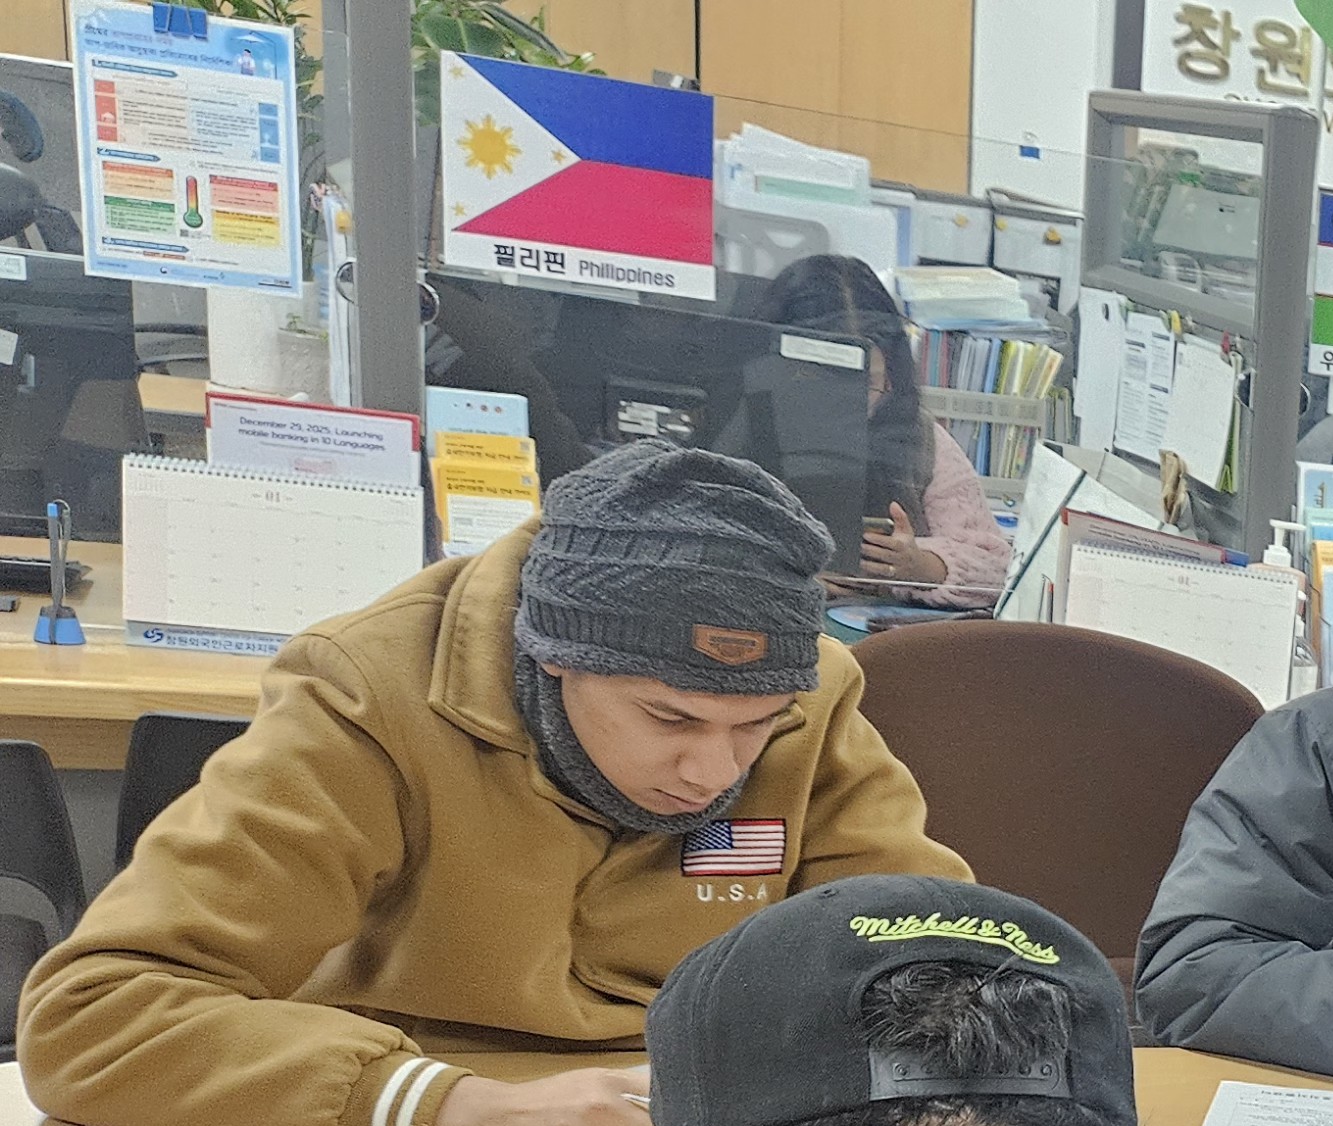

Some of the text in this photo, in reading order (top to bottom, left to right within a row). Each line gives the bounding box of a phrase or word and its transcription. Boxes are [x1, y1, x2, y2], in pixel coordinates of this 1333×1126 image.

[493, 244, 566, 275] 필리핀
[578, 259, 676, 288] Philippines
[238, 427, 269, 439] mobile
[272, 431, 308, 444] banking
[310, 435, 320, 444] in
[321, 436, 332, 445] 10
[239, 416, 287, 430] December
[335, 428, 384, 442] Launching
[696, 883, 767, 902] U.S.A
[849, 912, 1058, 959] Mitchell & Ness
